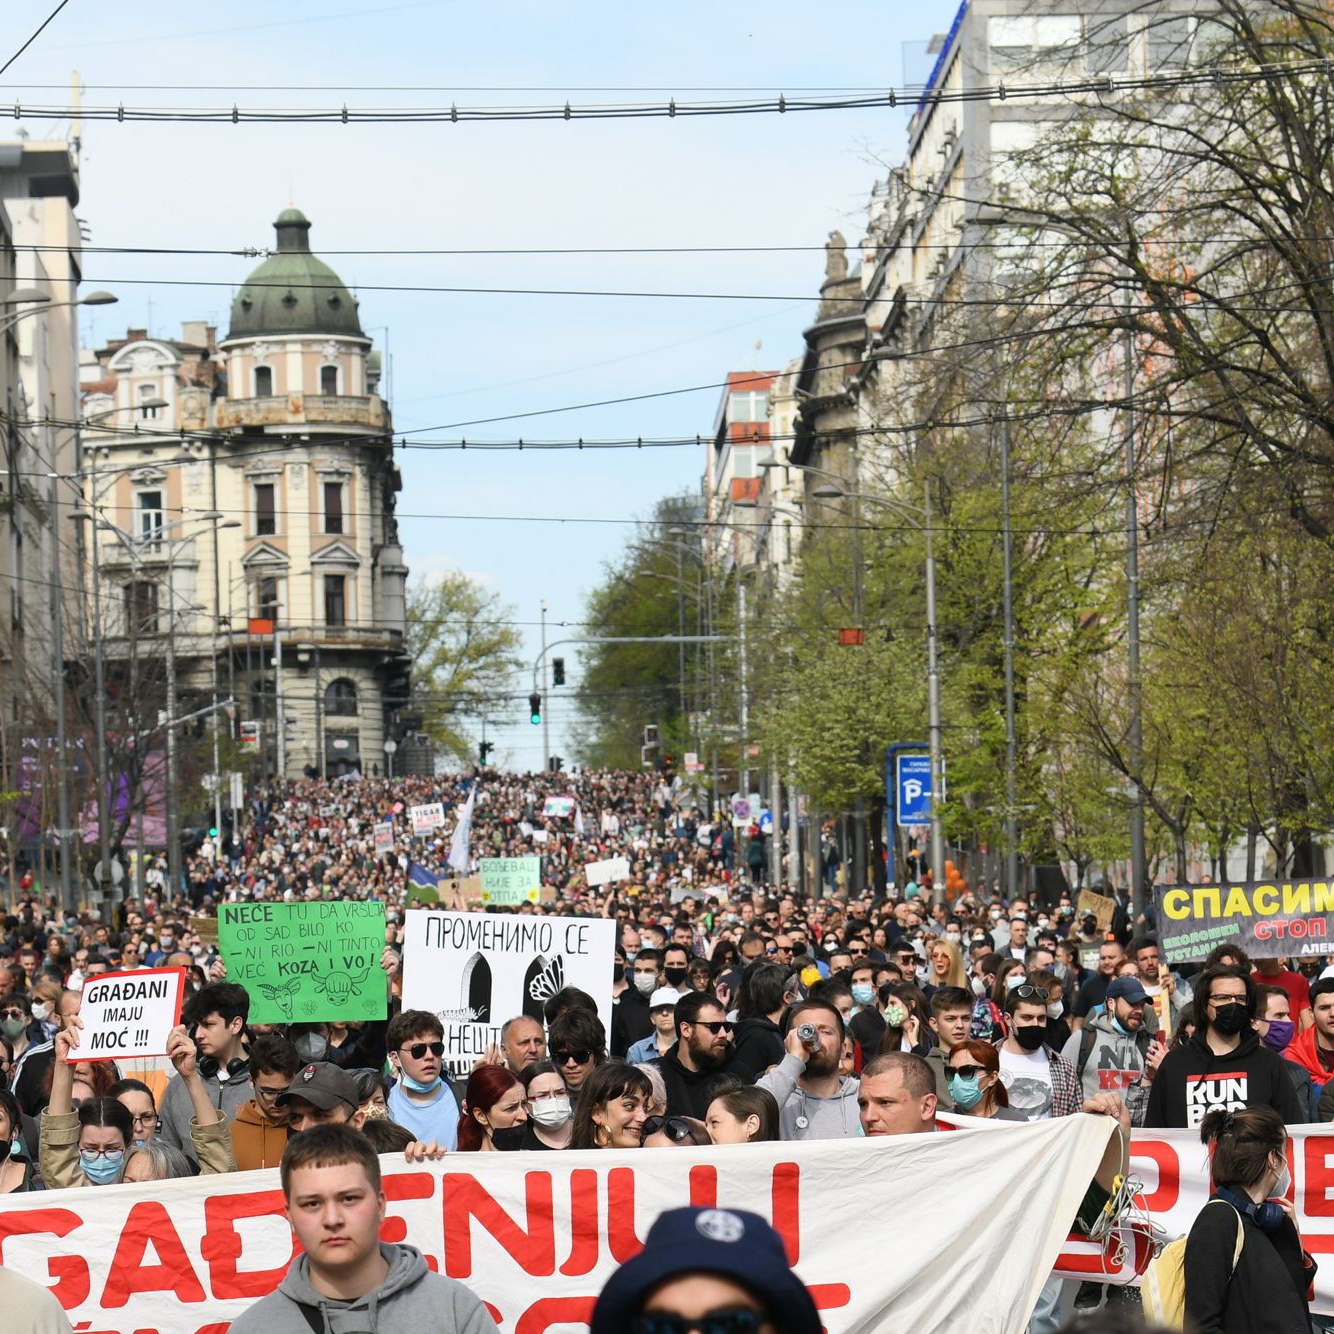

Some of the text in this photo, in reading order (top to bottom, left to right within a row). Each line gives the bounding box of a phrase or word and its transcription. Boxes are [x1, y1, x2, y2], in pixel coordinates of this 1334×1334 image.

[486, 876, 532, 887] НИЈЕ ЗА
[287, 904, 307, 920] TU
[320, 903, 338, 920] DA
[236, 921, 354, 942] OD SAD BILO KO
[426, 916, 589, 954] ПРОМЕНИМО СЕ
[1163, 923, 1240, 949] ЕКОЛОШКИ
[1253, 917, 1327, 940] СТОП
[272, 943, 294, 959] RIO
[339, 937, 380, 951] TINTO
[278, 960, 319, 977] KOZA
[330, 958, 334, 969] I
[88, 980, 168, 1004] GRAĐANI
[103, 1006, 143, 1023] IMAJU
[91, 1027, 149, 1050] MOĆ !!!
[448, 1024, 501, 1055] НЕШТ
[1186, 1077, 1248, 1105] RUN
